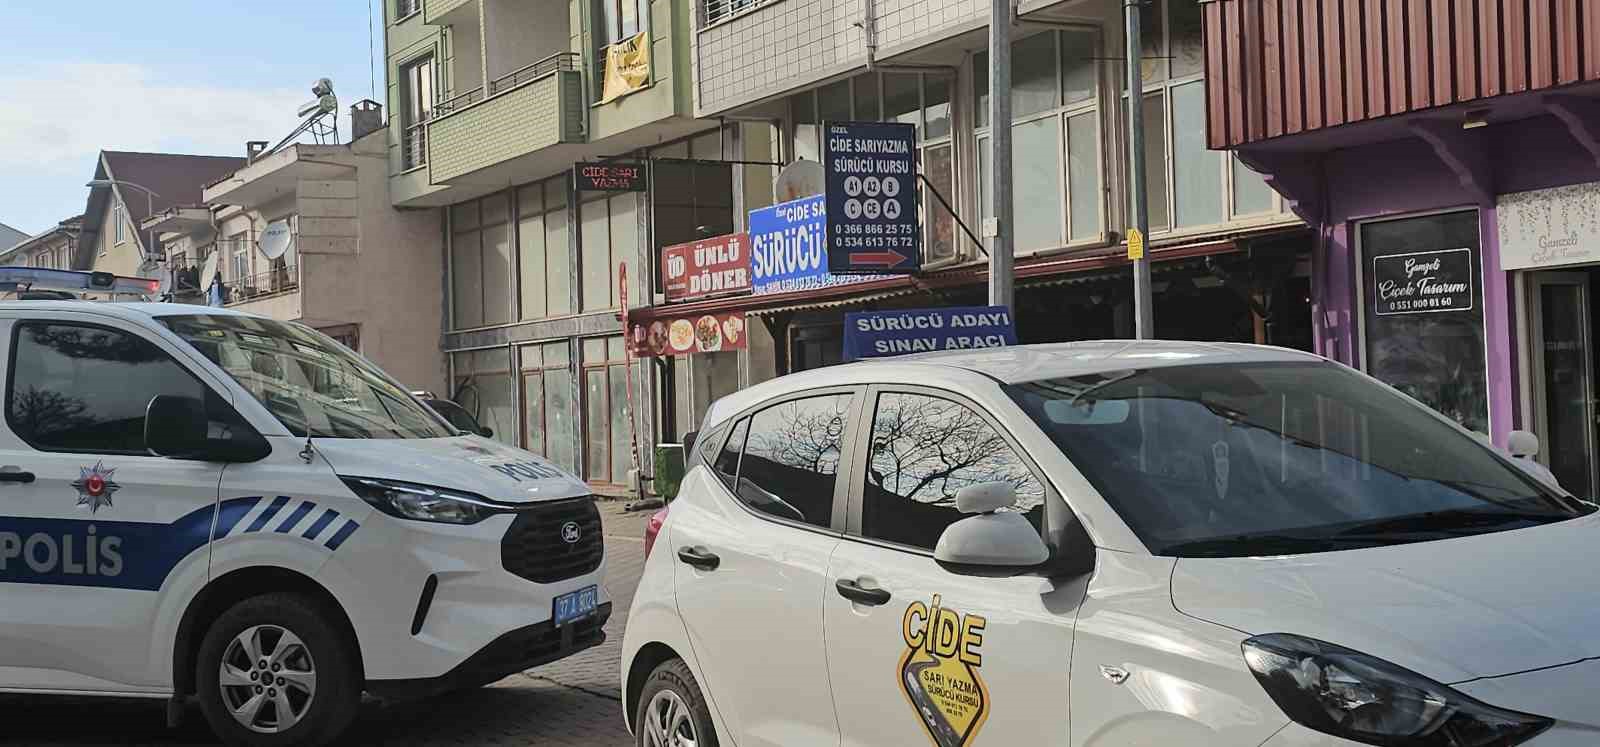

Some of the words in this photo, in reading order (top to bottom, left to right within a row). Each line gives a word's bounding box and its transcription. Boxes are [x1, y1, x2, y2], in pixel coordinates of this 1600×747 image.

[830, 134, 852, 152] CİDE
[854, 138, 909, 153] SARIYAZMA
[834, 155, 874, 173] SÜRÜCÜ
[876, 159, 909, 173] KURSU
[848, 181, 858, 193] A1
[867, 181, 877, 192] A2
[887, 181, 893, 193] B
[786, 200, 810, 222] CİDE
[850, 203, 856, 215] C
[866, 203, 877, 214] CE
[887, 201, 897, 214] A
[835, 224, 842, 234] 0
[844, 224, 862, 234] 366
[865, 224, 883, 234] 866
[885, 224, 898, 234] 25
[899, 224, 912, 234] 75
[752, 222, 822, 279] SÜRÜCÜ
[835, 237, 842, 247] 0
[845, 237, 864, 247] 534
[865, 237, 884, 247] 613
[885, 237, 898, 247] 76
[900, 237, 913, 247] 72
[694, 238, 740, 267] ÜNLÜ
[689, 265, 748, 293] DÖNER
[1416, 276, 1467, 296] Tasarım
[1390, 301, 1396, 310] 0
[1396, 300, 1411, 310] 551
[856, 312, 944, 332] SÜRÜCÜ
[950, 312, 1010, 328] ADAYI
[874, 338, 938, 354] SINAV
[944, 335, 1008, 350] ARACI
[0, 523, 122, 577] POLİS
[902, 593, 987, 667] CİDE
[927, 683, 955, 700] SÜRÜCÜ
[955, 694, 979, 708] KURSU
[947, 675, 978, 696] YAZMA
